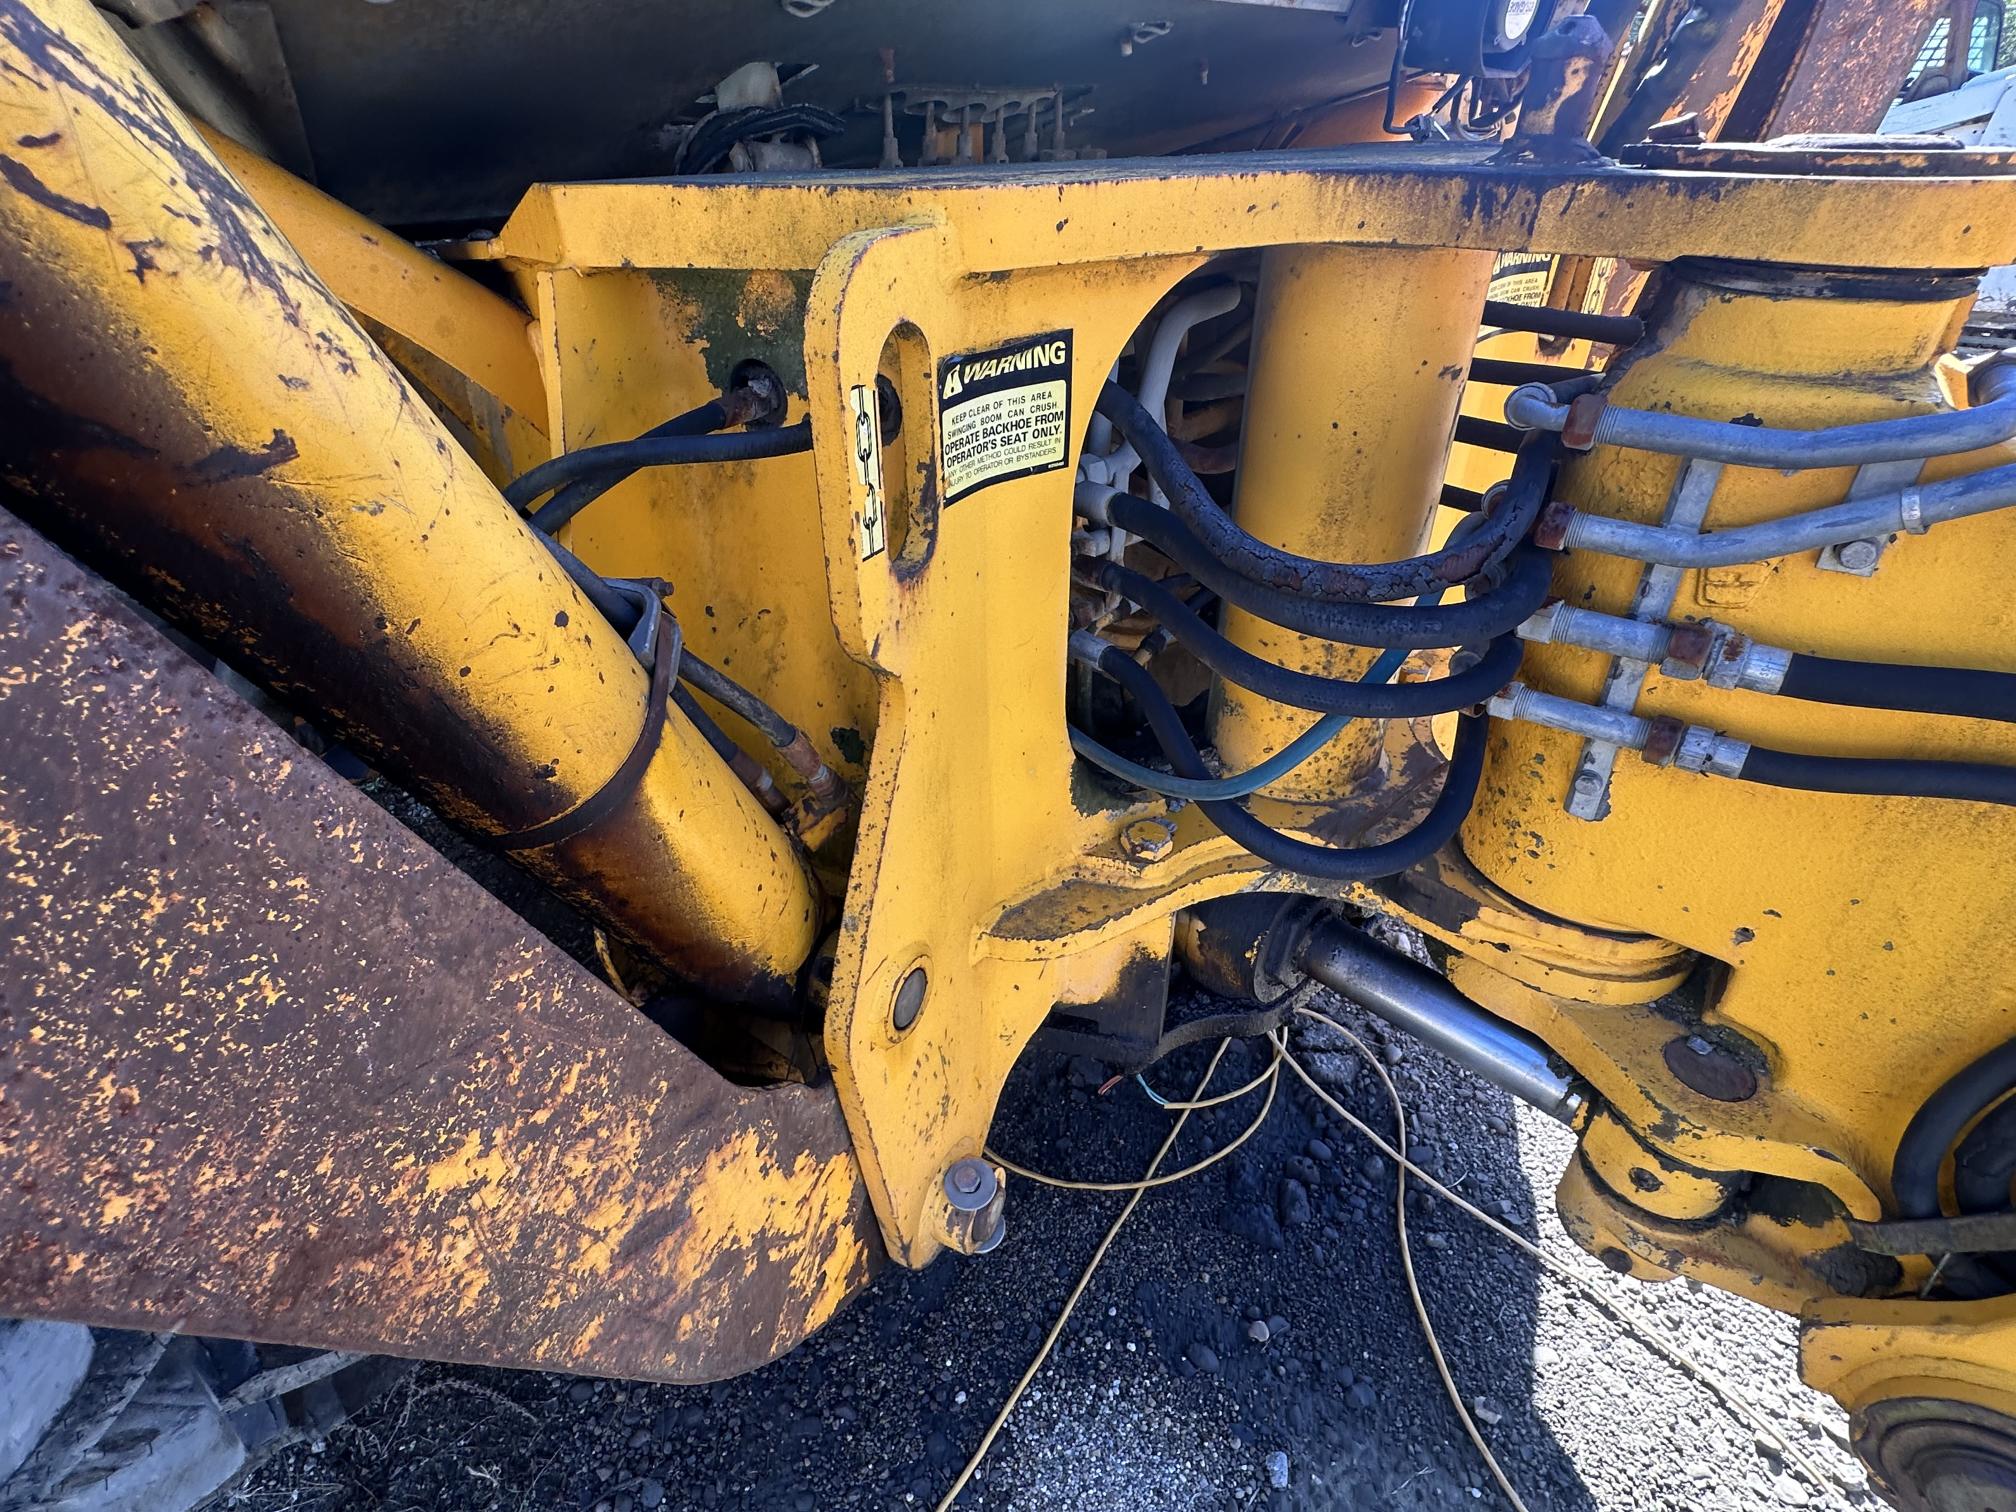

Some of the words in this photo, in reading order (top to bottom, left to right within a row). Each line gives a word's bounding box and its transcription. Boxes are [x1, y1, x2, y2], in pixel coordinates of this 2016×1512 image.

[963, 341, 1066, 384] WARNING
[947, 420, 976, 440] SWINGING
[980, 413, 1002, 426] BOOM
[1007, 408, 1025, 419] CAN
[1030, 401, 1058, 414] CRUSH
[952, 412, 967, 426] KEEP
[968, 403, 990, 418] CLEAR
[993, 400, 1003, 410] OF
[1008, 396, 1026, 407] THIS
[1030, 390, 1053, 402] AREA
[944, 431, 980, 456] OPERATE
[983, 417, 1032, 439] BACKHOE
[1035, 410, 1064, 427] FROM
[946, 439, 997, 468] OPERATOR'S
[1000, 432, 1028, 447] SEAT
[1032, 424, 1063, 439] ONLY.
[959, 460, 976, 473] OTHER
[977, 450, 1002, 464] METHOD
[1003, 444, 1026, 456] COULD
[1028, 438, 1053, 450] RESULT
[973, 459, 1003, 476] OPERATOR
[1004, 457, 1014, 466] OR
[1016, 447, 1057, 463] BYSTANDERS
